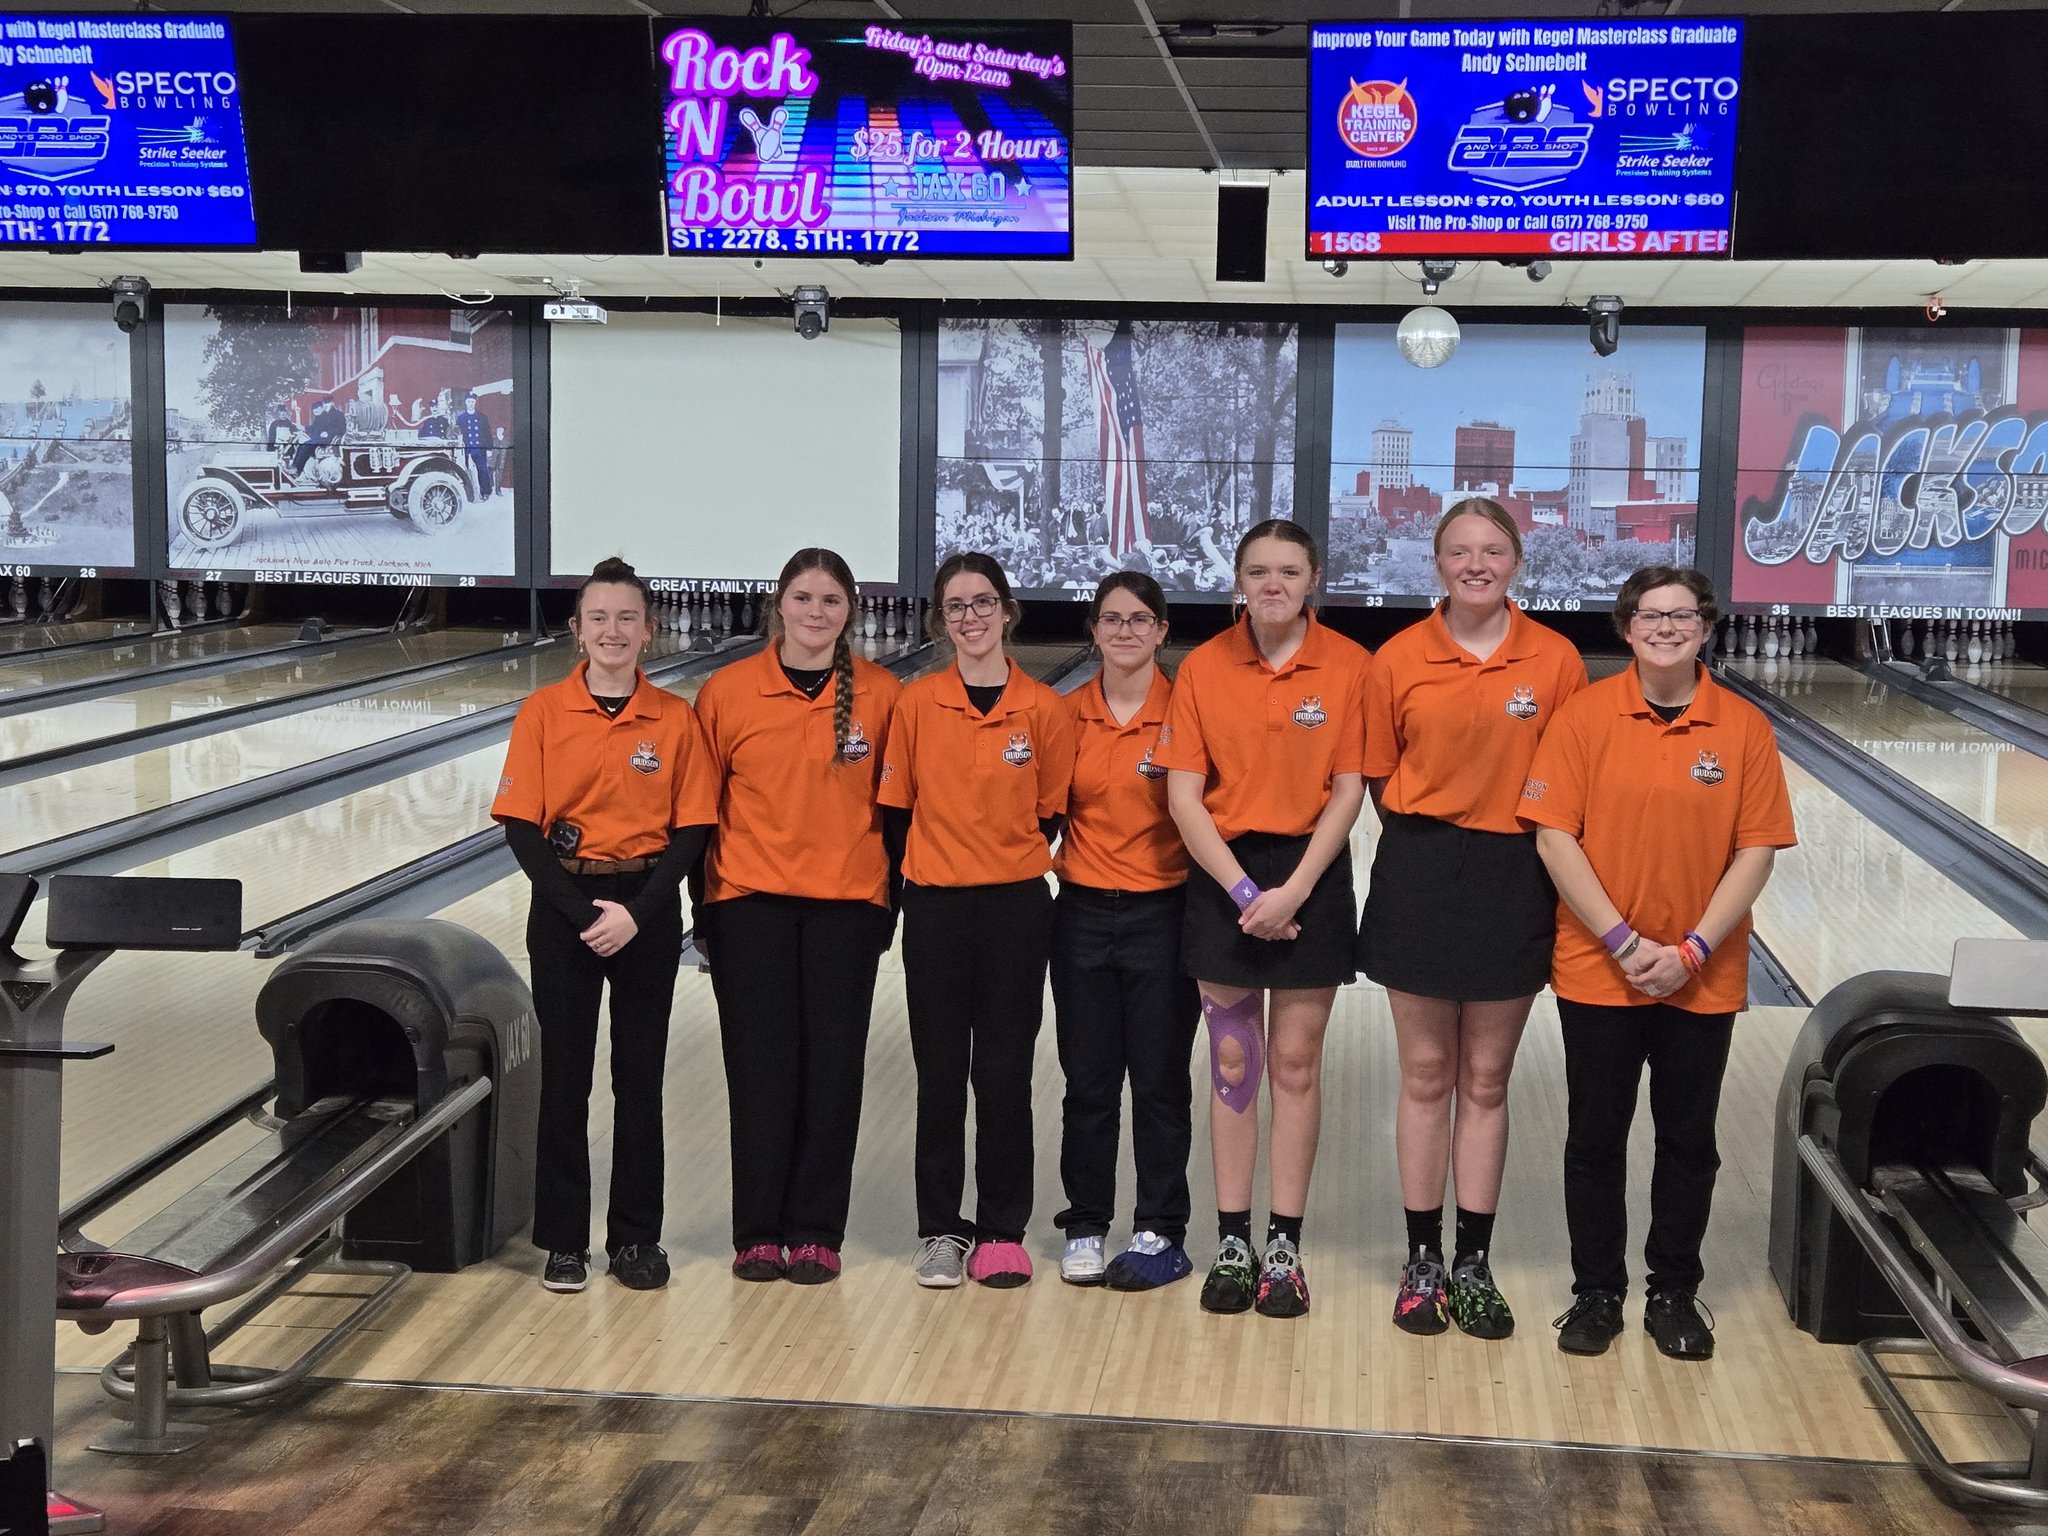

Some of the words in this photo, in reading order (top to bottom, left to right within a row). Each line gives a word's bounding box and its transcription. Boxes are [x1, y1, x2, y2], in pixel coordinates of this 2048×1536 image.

[5, 20, 37, 38] with
[38, 20, 76, 40] Kegel
[78, 21, 162, 39] Masterclass
[164, 22, 225, 39] Graduate
[1313, 31, 1372, 50] Improve
[1375, 31, 1407, 48] Your
[1410, 30, 1450, 47] Game
[1453, 29, 1494, 49] Today
[1499, 29, 1530, 46] with
[1534, 28, 1574, 48] Kegel
[1577, 28, 1667, 45] Masterclass
[1671, 26, 1737, 44] Graduate
[16, 44, 94, 64] Schnebelt
[865, 26, 934, 58] Friday's
[935, 42, 972, 61] and
[972, 42, 1066, 79] Saturday's
[664, 31, 818, 95] Rock
[1462, 54, 1501, 73] Andy
[1506, 52, 1587, 71] Schnebelt
[914, 55, 1012, 87] 10pm-12am
[116, 71, 236, 95] SPECTO
[1607, 77, 1738, 101] SPECTO
[120, 97, 231, 109] BOWLING
[1608, 103, 1728, 116] BOWLING
[1351, 104, 1404, 118] KEGEL
[668, 98, 727, 161] N
[1344, 118, 1411, 131] TRAINING
[1350, 131, 1405, 143] CENTER
[139, 147, 177, 159] Strike
[180, 147, 226, 159] Seeker
[850, 129, 904, 161] $25
[903, 131, 947, 166] for
[955, 131, 972, 159] 2
[978, 131, 1061, 160] Hours
[171, 161, 199, 169] Training
[1616, 154, 1659, 168] Strike
[1662, 154, 1713, 168] Seeker
[1651, 169, 1680, 177] Training
[1682, 169, 1712, 177] Systems
[15, 184, 53, 197] $70,
[56, 185, 121, 196] YOUTH
[124, 186, 205, 197] LESSON:
[208, 185, 244, 198] $60
[907, 173, 965, 201] JAX
[971, 173, 1006, 200] 60
[674, 164, 831, 228] Bowl
[1315, 195, 1383, 208] ADULT
[1387, 194, 1474, 208] LESSON:
[1476, 194, 1516, 208] $70,
[1522, 194, 1590, 207] YOUTH
[1594, 194, 1681, 207] LESSON:
[1684, 193, 1724, 206] $60
[48, 206, 60, 219] or
[63, 204, 87, 219] Call
[89, 204, 118, 219] (517)
[121, 204, 179, 220] 768-9750
[1388, 215, 1416, 230] Visit
[1419, 214, 1442, 230] The
[1444, 214, 1503, 231] Pro-Shop
[1506, 217, 1521, 229] or
[1523, 214, 1548, 229] Call
[1551, 214, 1583, 230] (517)
[1586, 213, 1648, 229] 768-9750
[51, 221, 111, 242] 1772
[672, 231, 714, 249] ST:
[721, 230, 788, 251] 2278,
[794, 230, 853, 250] 5TH:
[860, 231, 919, 250] 1772
[1320, 232, 1381, 253] 1568
[1550, 231, 1635, 253] GIRLS
[1745, 417, 2048, 565] JACKSO
[15, 566, 31, 577] 60
[80, 568, 96, 578] 26
[206, 571, 222, 581] 27
[255, 571, 291, 582] BEST
[294, 571, 361, 584] LEAGUES
[364, 574, 377, 585] IN
[381, 574, 432, 586] TOWN!!
[459, 576, 476, 587] 28
[650, 579, 698, 592] GREAT
[702, 580, 753, 593] FAMILY
[757, 582, 778, 594] FU
[1366, 596, 1384, 607] 33
[1532, 598, 1561, 611] JAX
[1564, 599, 1581, 611] 60
[1771, 604, 1790, 616] 35
[1827, 606, 1866, 618] BEST
[1870, 606, 1943, 619] LEAGUES
[1947, 607, 1961, 619] IN
[1966, 607, 2022, 621] TOWN!!
[1509, 703, 1537, 714] HUDSON
[1295, 712, 1325, 721] HUDSON
[842, 744, 868, 754] UDSON
[1005, 751, 1032, 760] HUDSON
[632, 757, 659, 768] HUDSON
[1694, 768, 1722, 780] HUDSON
[1526, 779, 1548, 791] DSON
[505, 1017, 521, 1074] JAX
